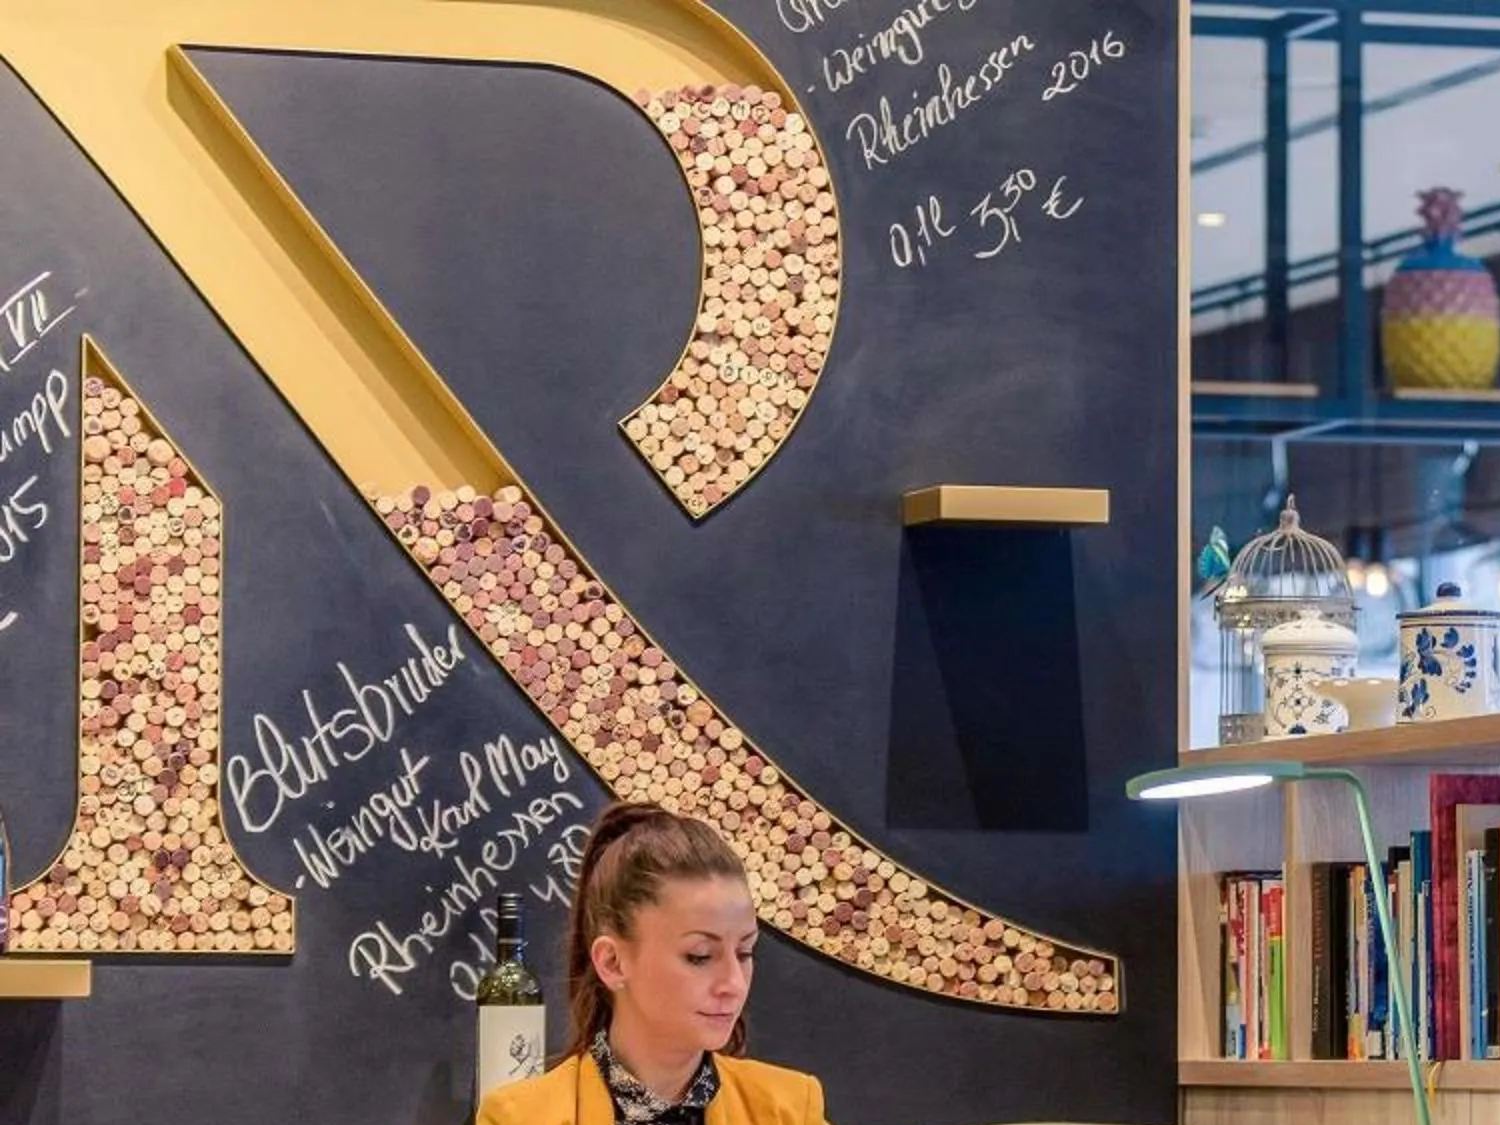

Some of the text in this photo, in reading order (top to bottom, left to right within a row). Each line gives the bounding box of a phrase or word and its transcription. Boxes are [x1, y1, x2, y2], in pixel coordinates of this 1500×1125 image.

[846, 30, 1126, 171] Rheinhessen 2016
[483, 733, 570, 799] May
[348, 790, 585, 996] Rheinhessen
